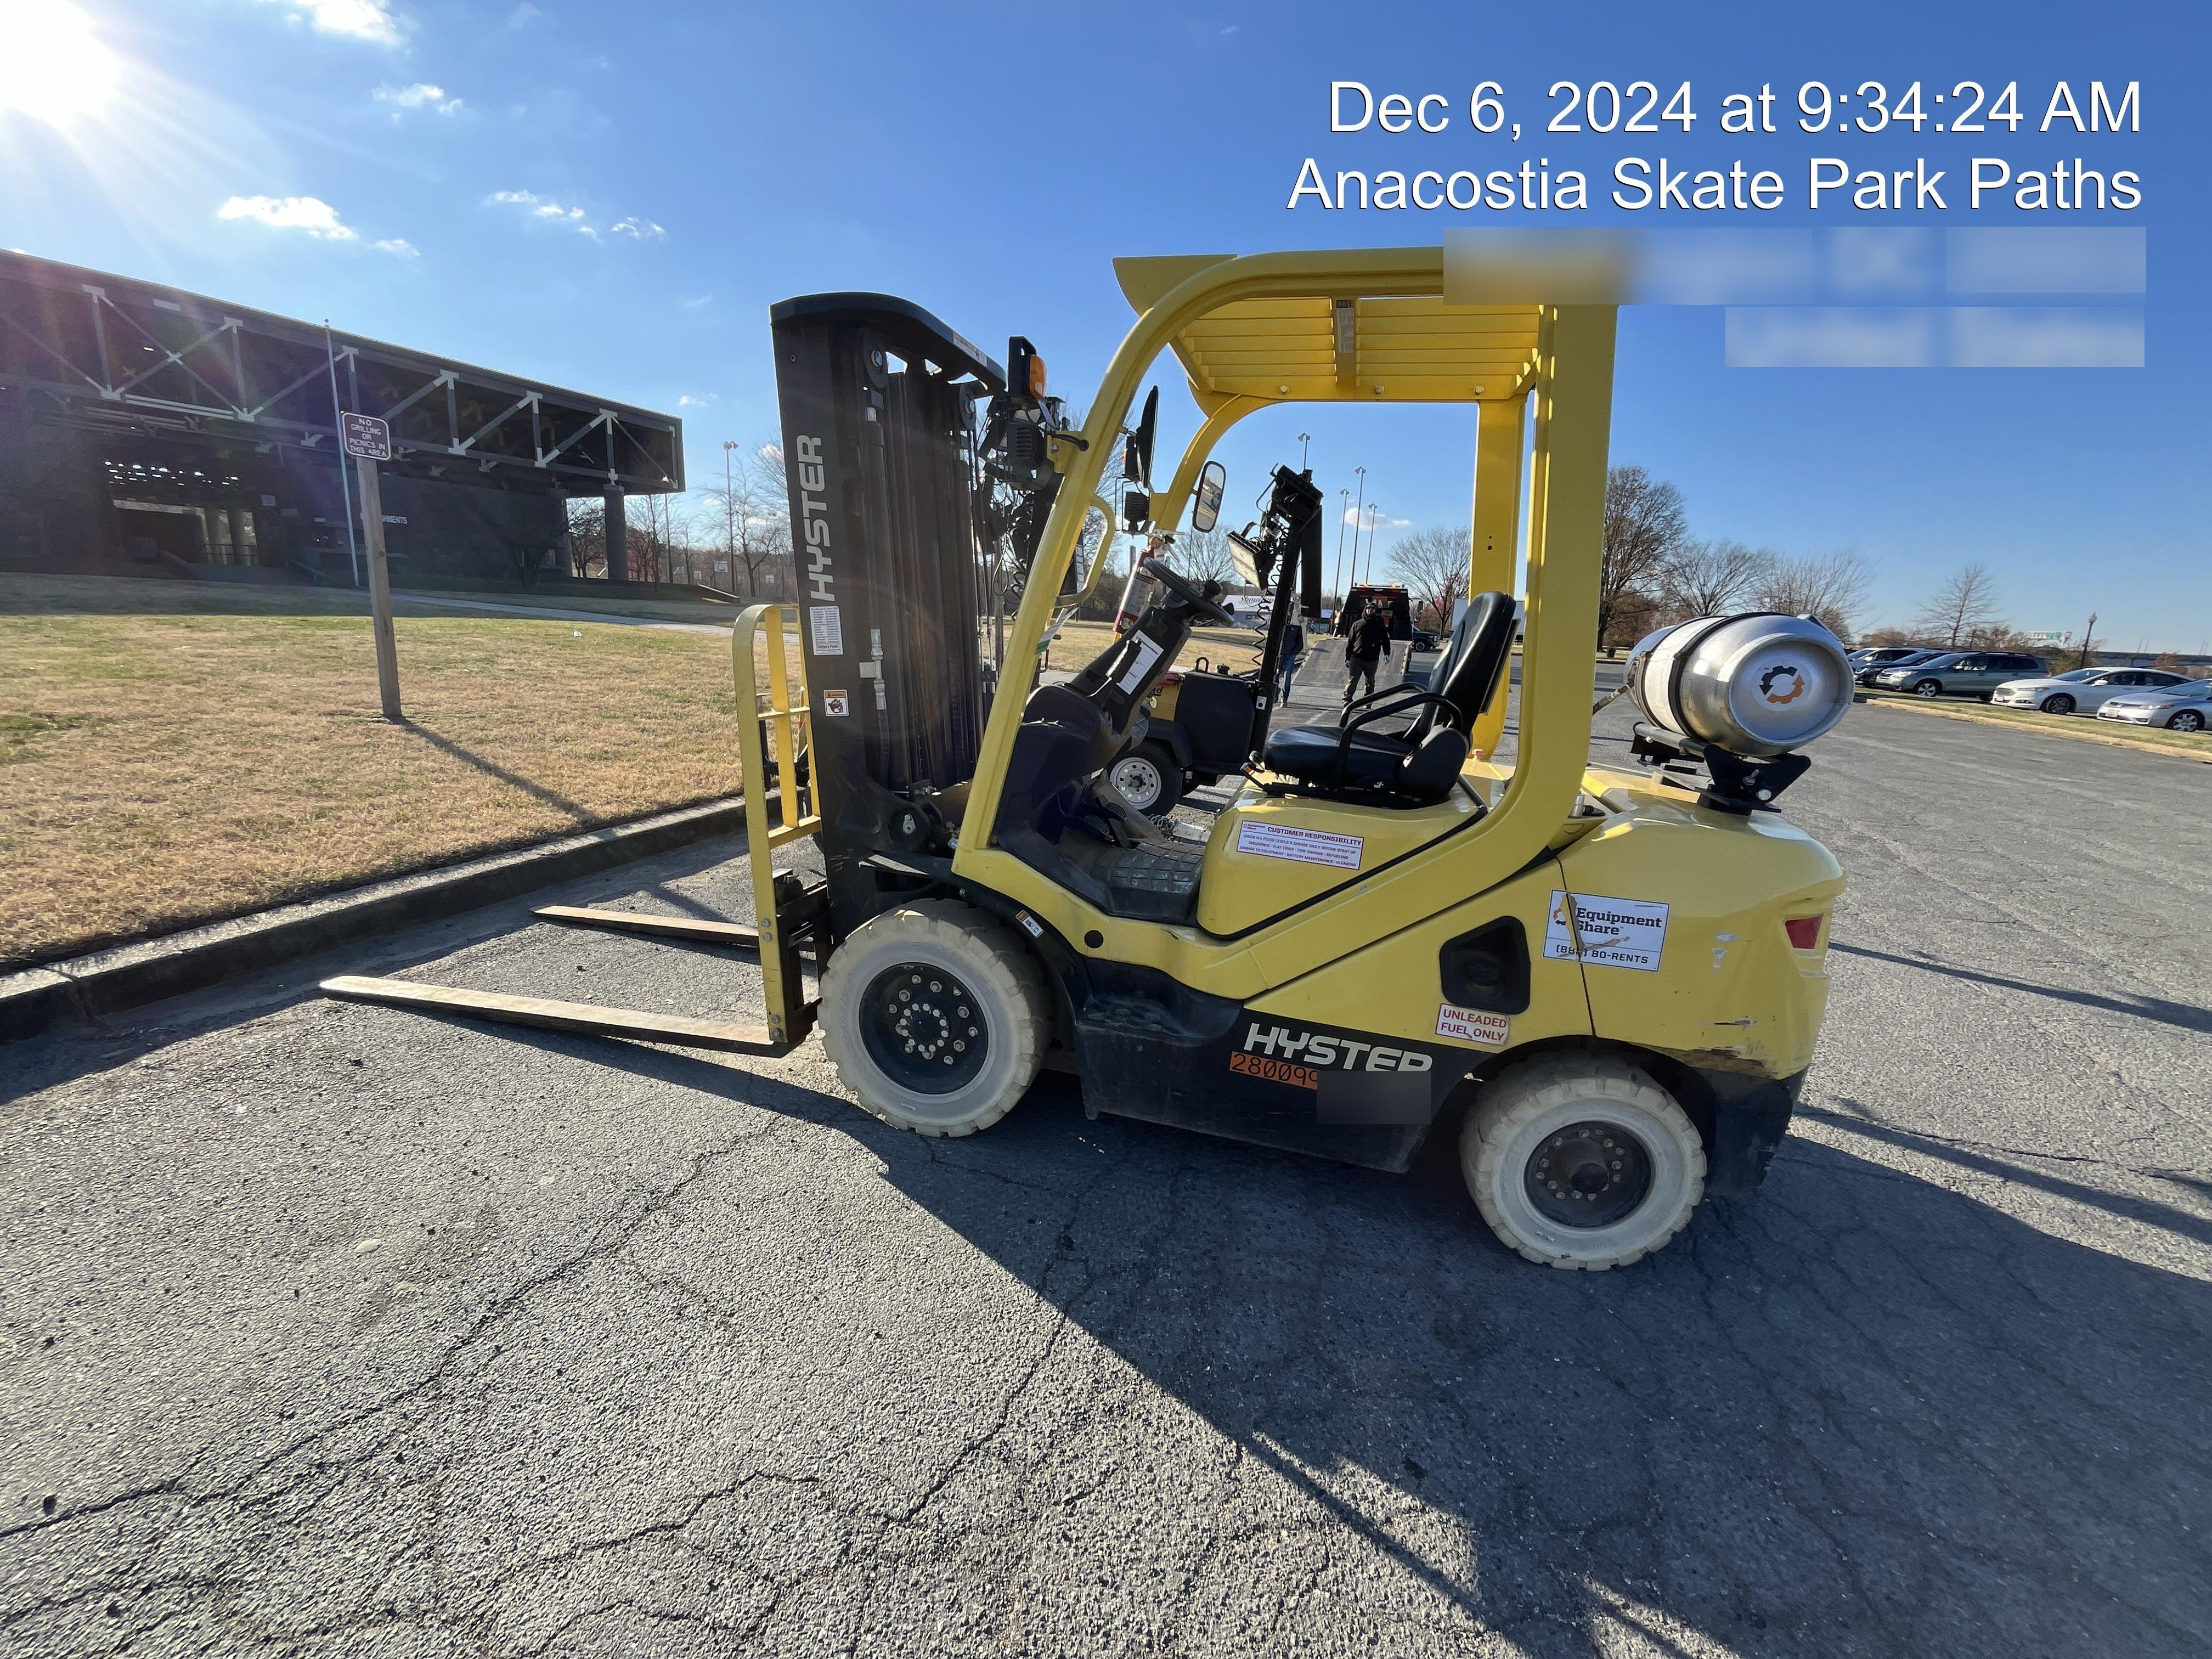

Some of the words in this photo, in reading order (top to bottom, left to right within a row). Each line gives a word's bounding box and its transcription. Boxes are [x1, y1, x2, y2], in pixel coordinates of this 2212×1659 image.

[351, 424, 381, 435] GRILLING
[358, 418, 372, 426] NO
[349, 438, 376, 448] PICNICS
[349, 445, 365, 454] THIS
[368, 448, 387, 457] AREA
[797, 435, 835, 601] HYSTER
[1267, 827, 1303, 837] CUSTOMER
[1304, 832, 1361, 845] RESPONSIBILITY
[1576, 907, 1662, 928] Equipment
[1592, 950, 1648, 964] 80-RENTS
[1443, 1009, 1507, 1028] UNLEADED
[1441, 1022, 1469, 1035] FUEL
[1473, 1028, 1505, 1041] ONLY
